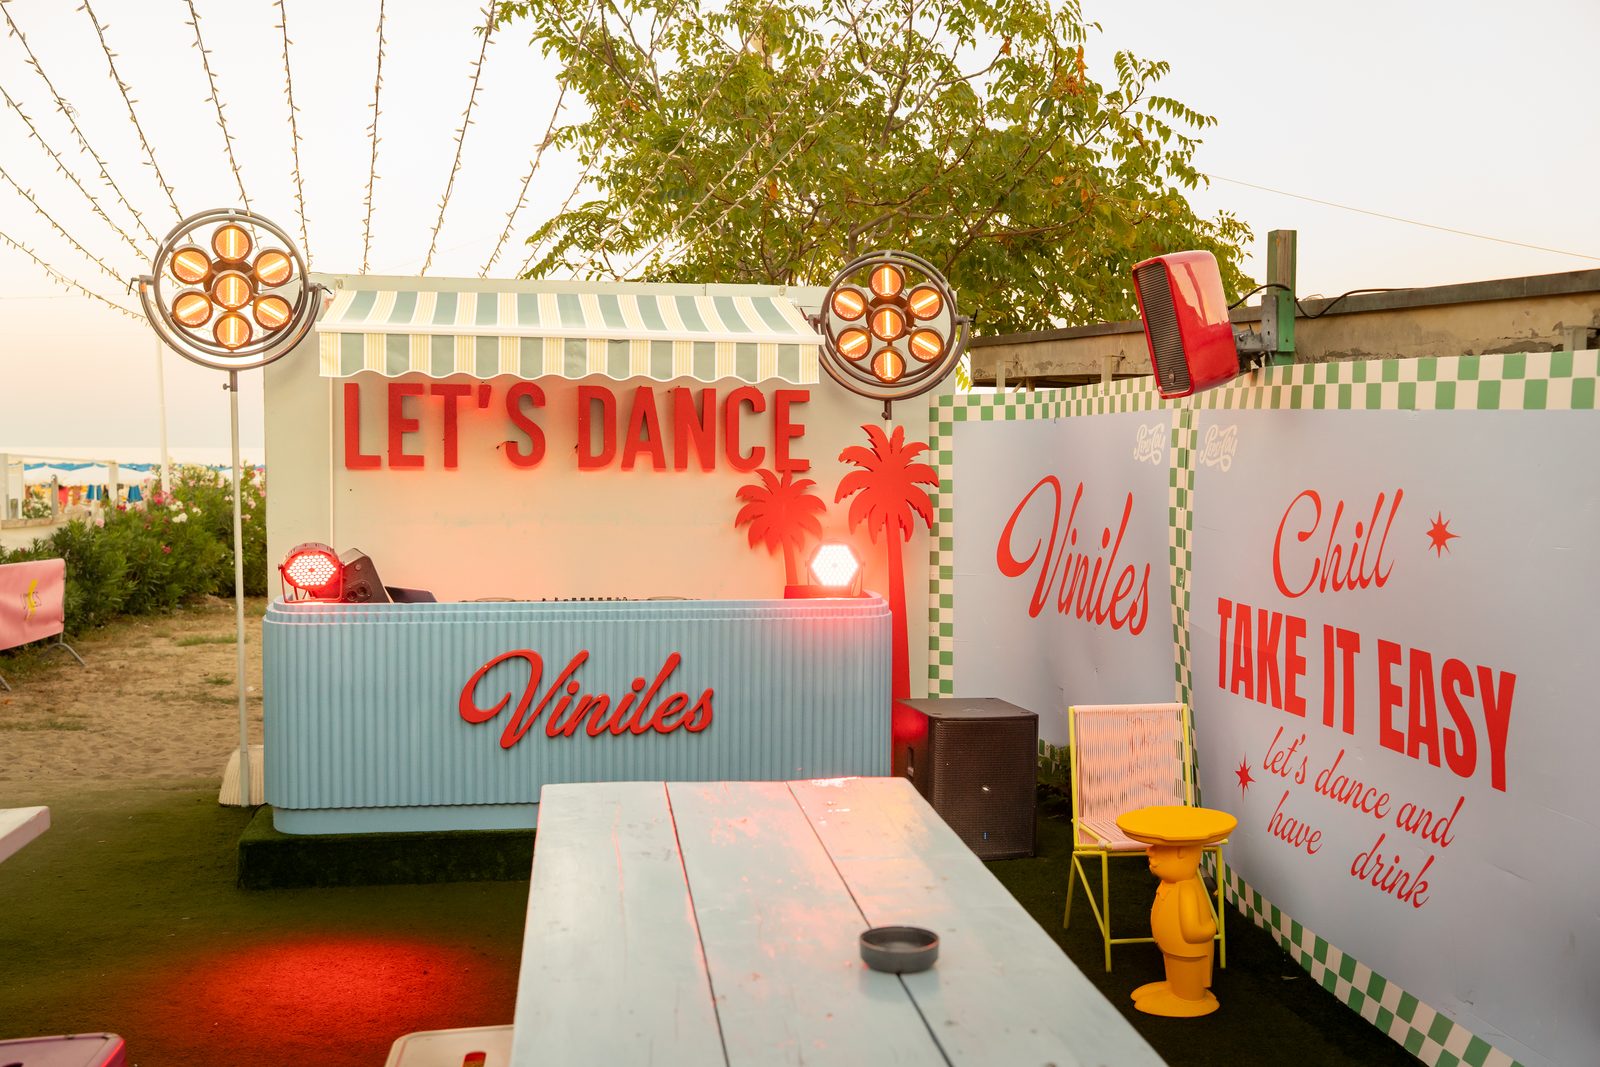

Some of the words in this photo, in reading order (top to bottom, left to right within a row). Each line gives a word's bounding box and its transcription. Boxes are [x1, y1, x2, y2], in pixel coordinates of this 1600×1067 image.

[344, 381, 547, 470] LET'S
[577, 384, 811, 474] DANCE
[996, 475, 1151, 636] Viniles
[1273, 488, 1404, 599] Chill
[458, 649, 714, 752] Viniles
[1217, 597, 1307, 719] TAKE
[1323, 623, 1361, 736] IT
[1377, 639, 1517, 792] EASY
[1263, 726, 1309, 785] let's
[1314, 749, 1391, 819] dance
[1396, 796, 1465, 848] and
[1267, 790, 1323, 855] have
[1350, 833, 1435, 908] drink
